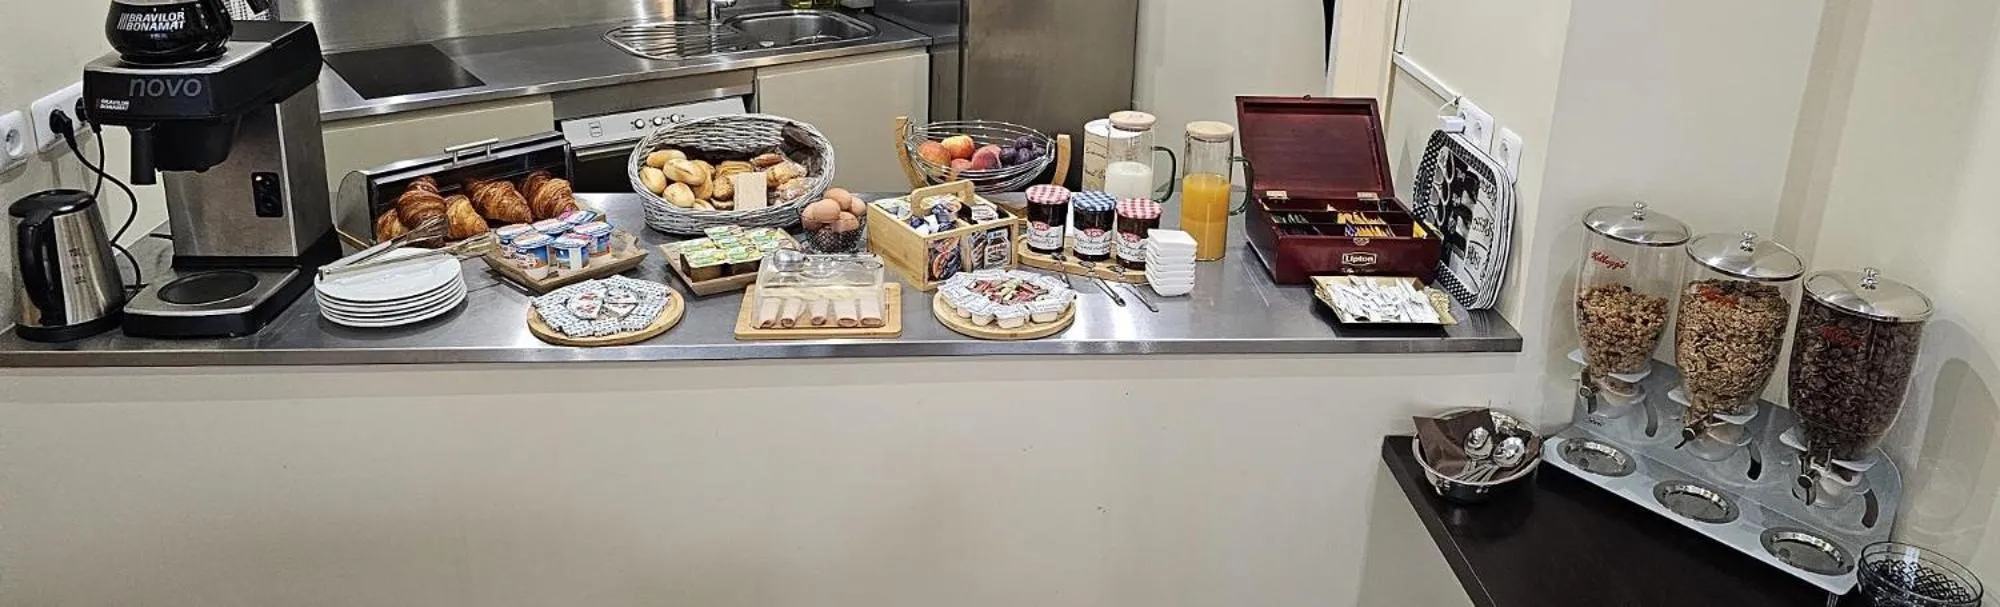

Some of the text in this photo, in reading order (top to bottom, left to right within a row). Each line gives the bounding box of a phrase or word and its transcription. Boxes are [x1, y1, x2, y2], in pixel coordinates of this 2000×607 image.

[128, 11, 185, 22] BRAVILOR
[125, 20, 185, 32] BONAMAT
[128, 78, 202, 97] novo
[1346, 255, 1374, 264] Lipton
